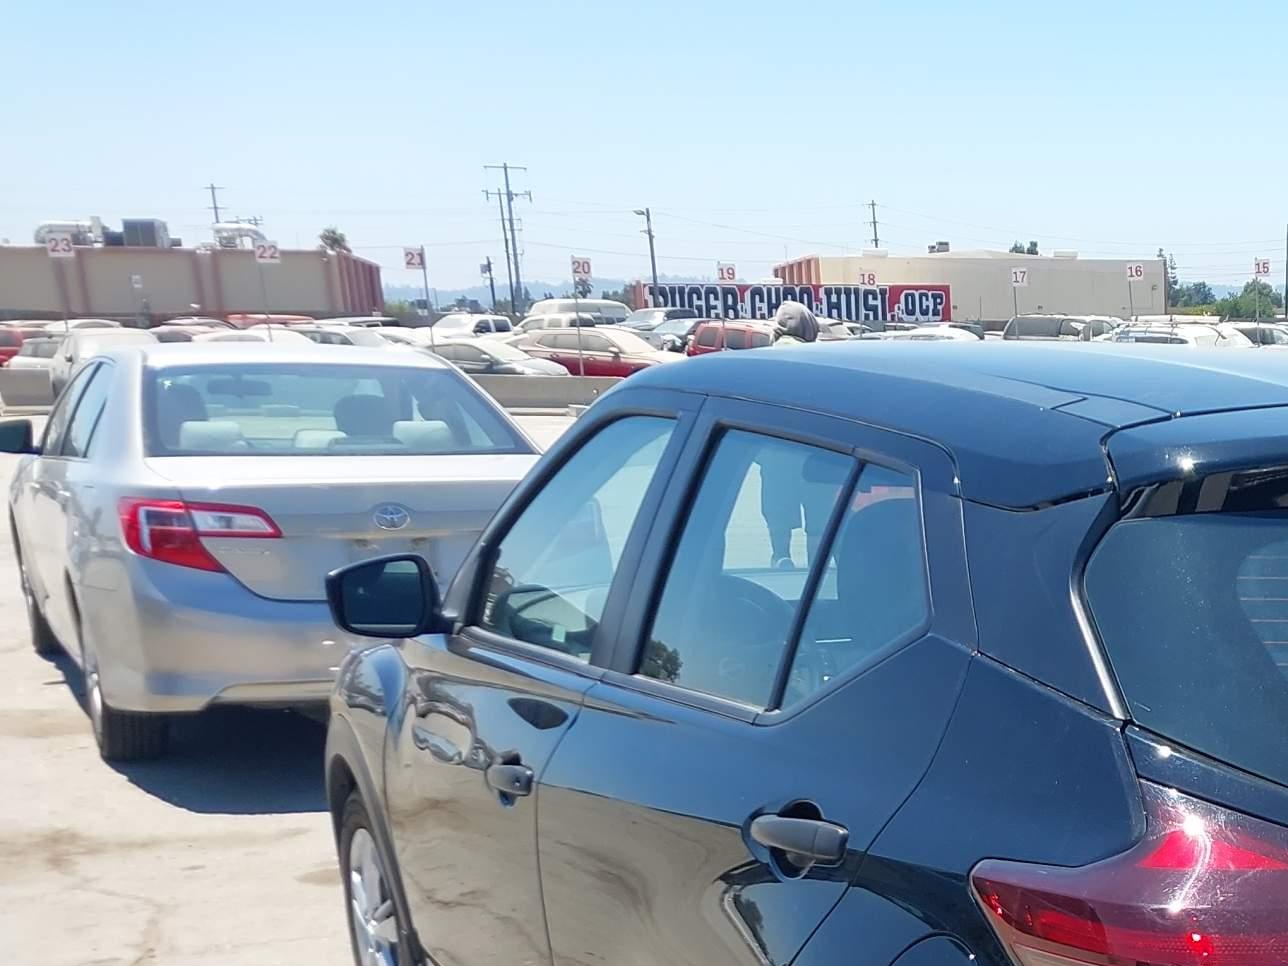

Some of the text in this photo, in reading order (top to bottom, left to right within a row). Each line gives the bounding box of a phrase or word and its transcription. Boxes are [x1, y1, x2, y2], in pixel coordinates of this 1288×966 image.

[51, 238, 71, 253] 23
[257, 245, 278, 259] 22
[405, 252, 424, 266] 21
[572, 261, 591, 274] 20
[719, 267, 735, 280] 19
[1127, 265, 1143, 278] 16
[1255, 262, 1270, 274] 15
[860, 273, 876, 286] 18
[1012, 271, 1026, 283] 17
